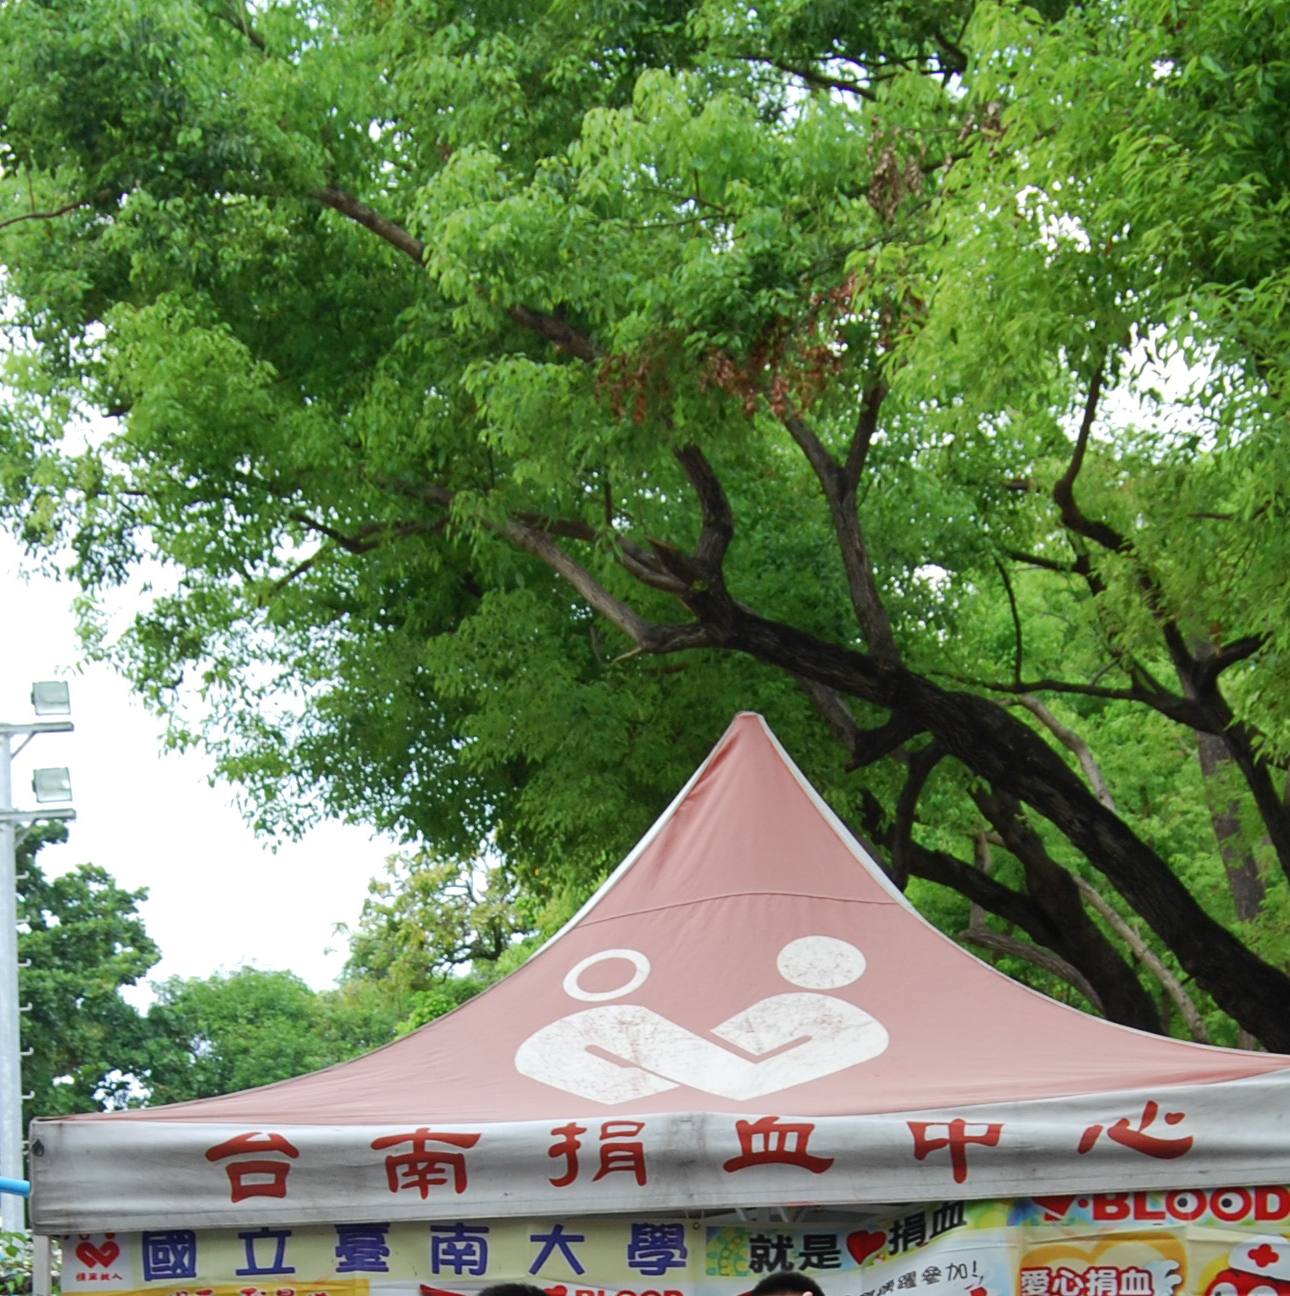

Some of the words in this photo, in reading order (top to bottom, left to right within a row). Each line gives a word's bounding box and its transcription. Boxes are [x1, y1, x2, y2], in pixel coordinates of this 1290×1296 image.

[205, 1100, 1195, 1203] 台南捐血中心
[141, 1222, 689, 1282] 國立臺南大學
[748, 1233, 843, 1274] 就是
[888, 1200, 967, 1256] 捐血
